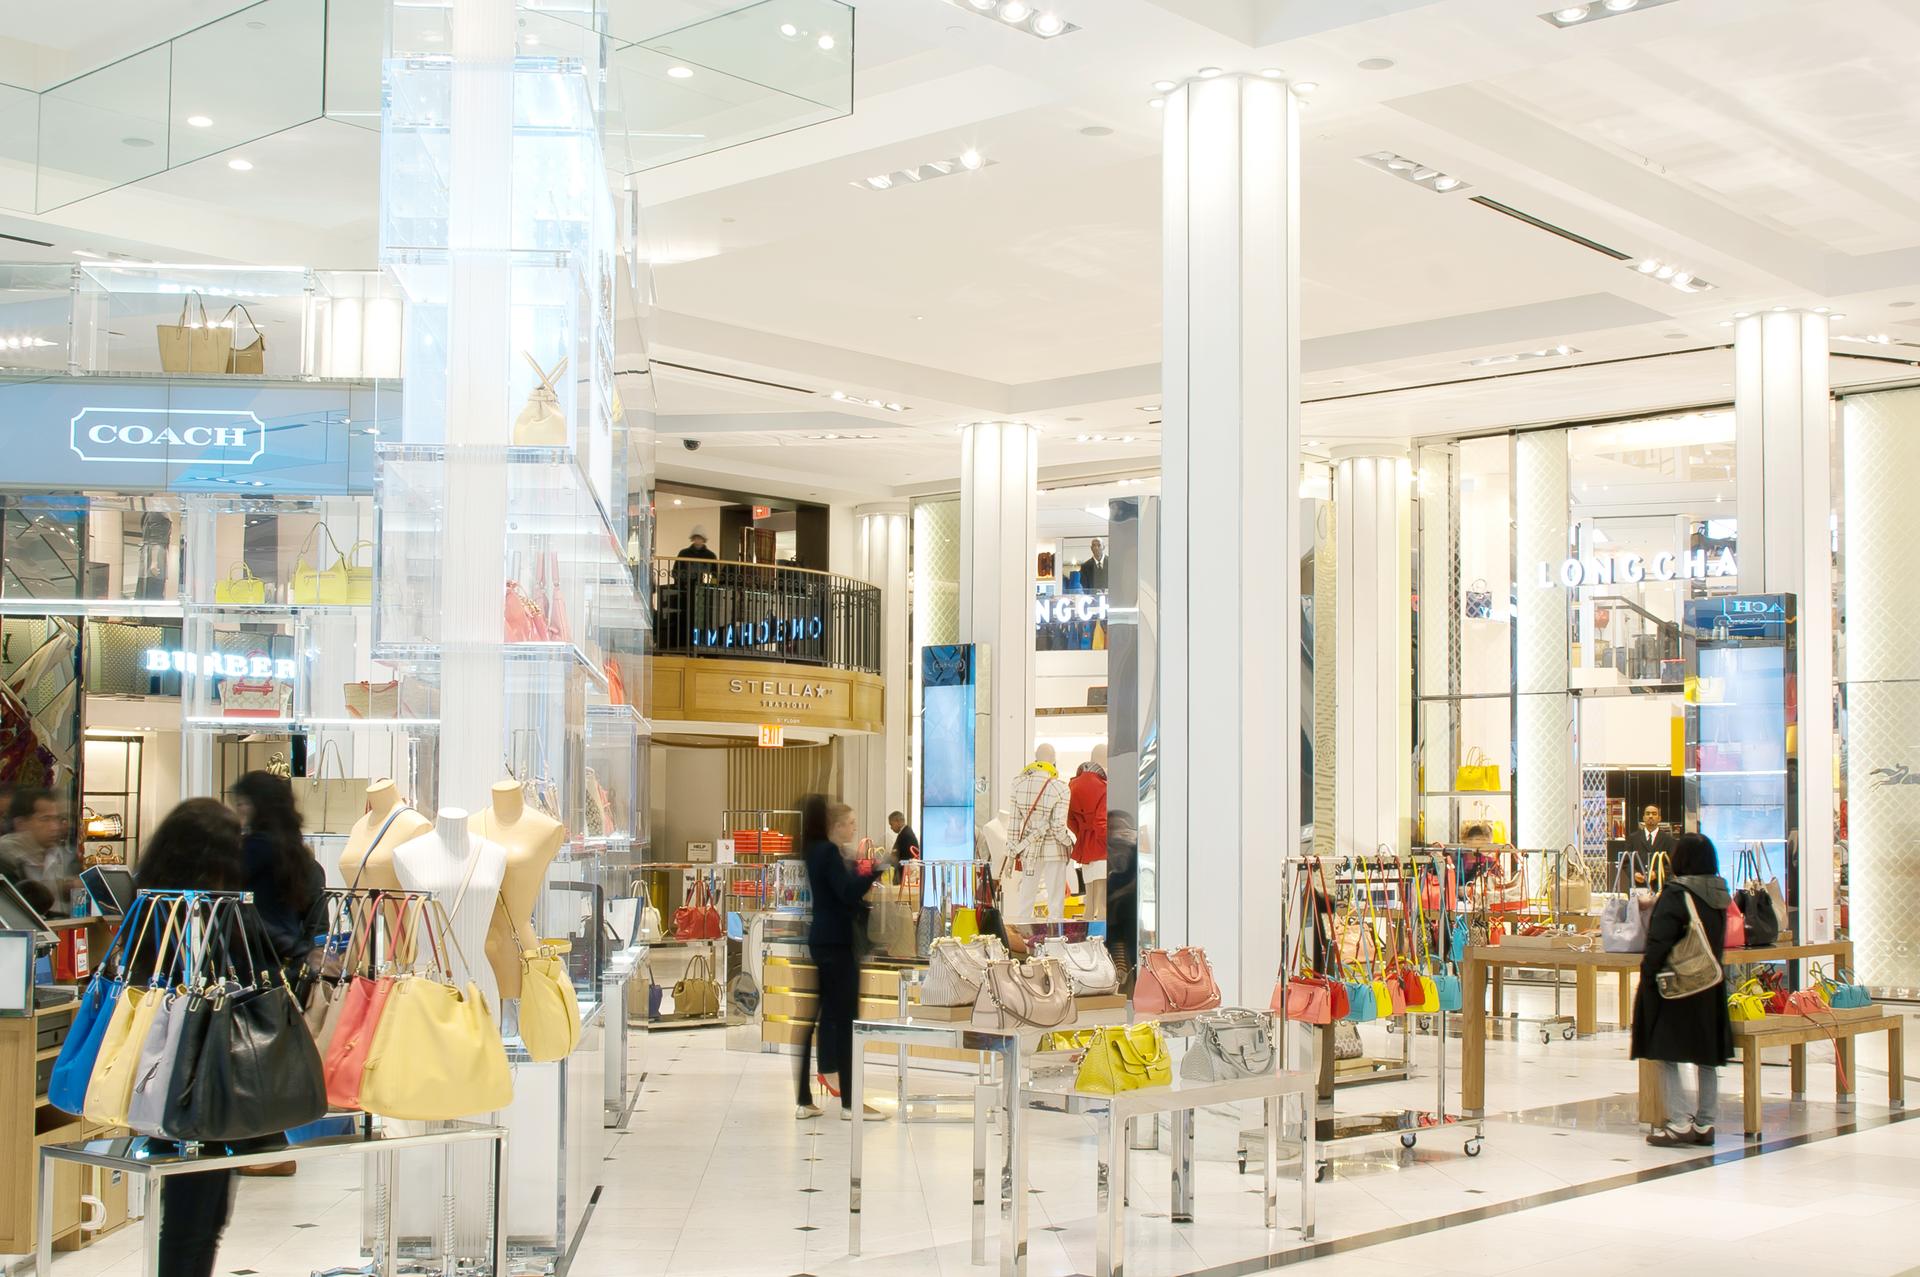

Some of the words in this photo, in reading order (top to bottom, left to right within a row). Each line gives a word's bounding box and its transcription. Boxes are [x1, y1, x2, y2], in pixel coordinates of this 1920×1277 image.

[88, 424, 247, 447] COACH
[1538, 547, 1738, 588] LONGCHA
[730, 679, 813, 697] STELLA
[762, 727, 780, 745] EXIT
